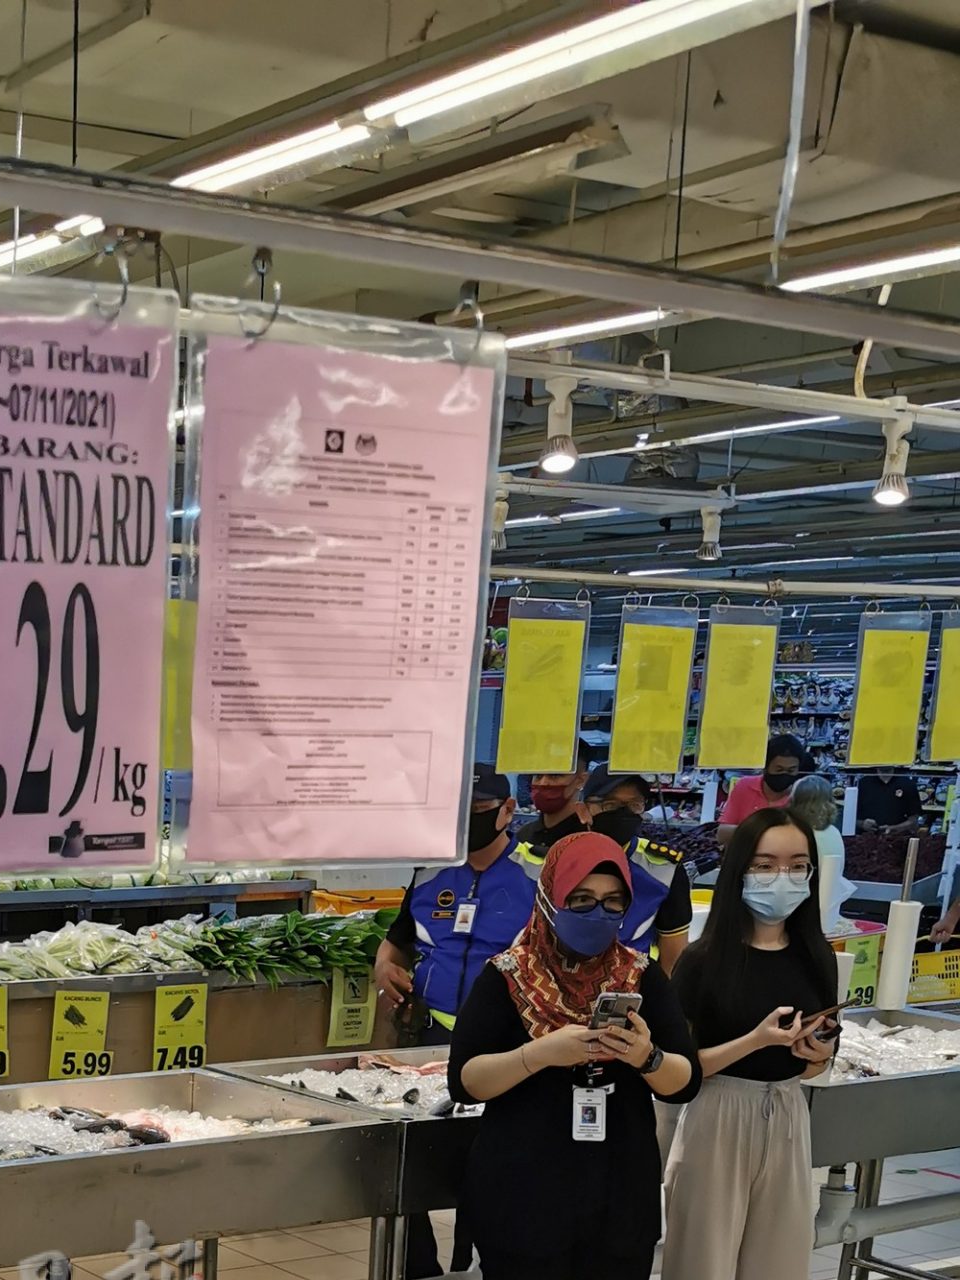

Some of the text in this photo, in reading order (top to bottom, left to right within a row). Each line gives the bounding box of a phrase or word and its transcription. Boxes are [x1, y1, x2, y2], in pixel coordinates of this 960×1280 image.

[41, 340, 150, 379] Terkawal
[62, 1052, 111, 1075] 5.99
[156, 1045, 204, 1071] 7.49
